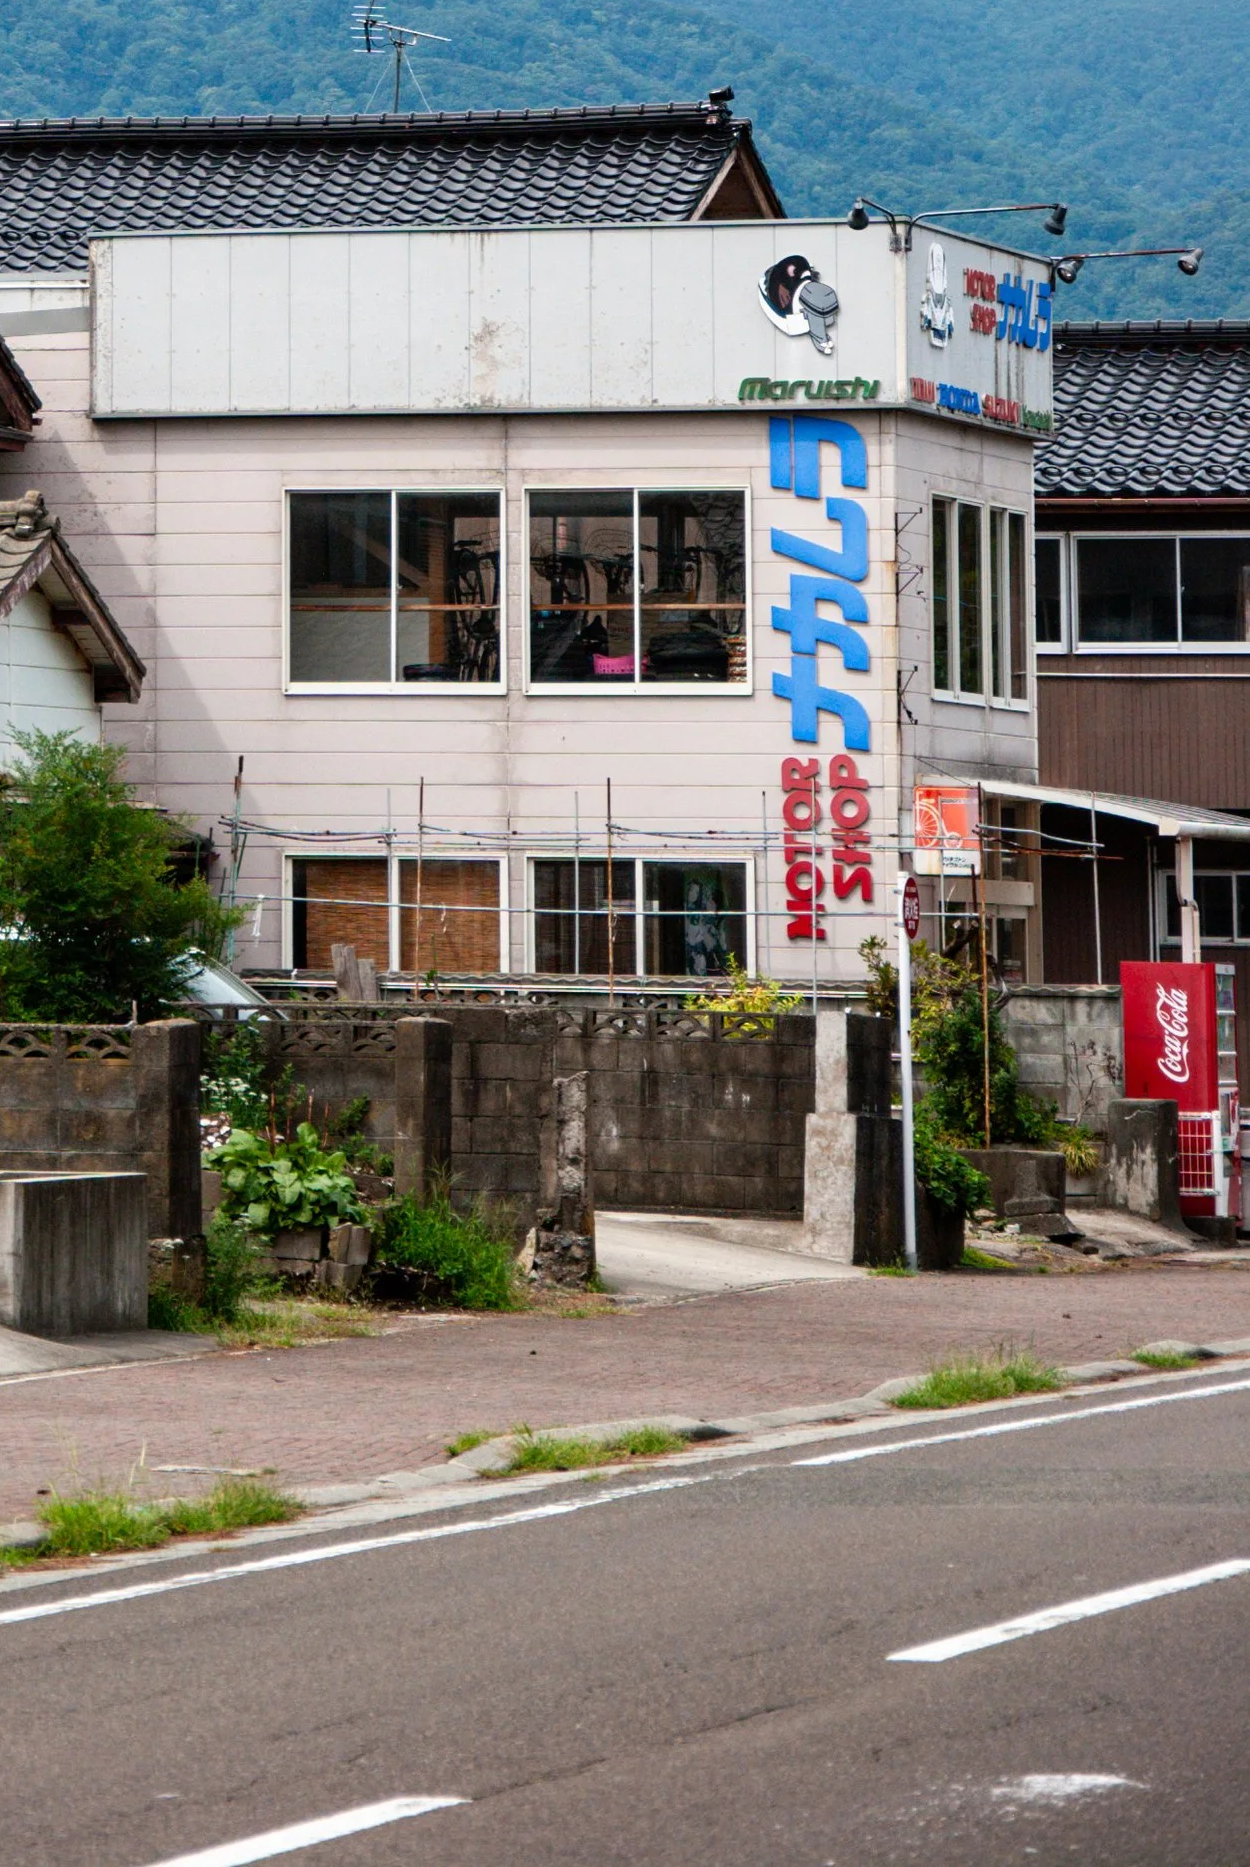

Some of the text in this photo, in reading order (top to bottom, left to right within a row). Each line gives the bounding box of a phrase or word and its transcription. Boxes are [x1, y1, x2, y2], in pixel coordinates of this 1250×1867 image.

[964, 268, 996, 302] MOTOR
[997, 272, 1052, 352] ナカムラ
[971, 303, 997, 335] SHOP
[738, 376, 881, 400] Maruishi
[983, 394, 1019, 424] SUZUKI
[768, 415, 871, 752] ナカムラ
[781, 757, 826, 940] MOTOR
[829, 754, 873, 902] SHOP
